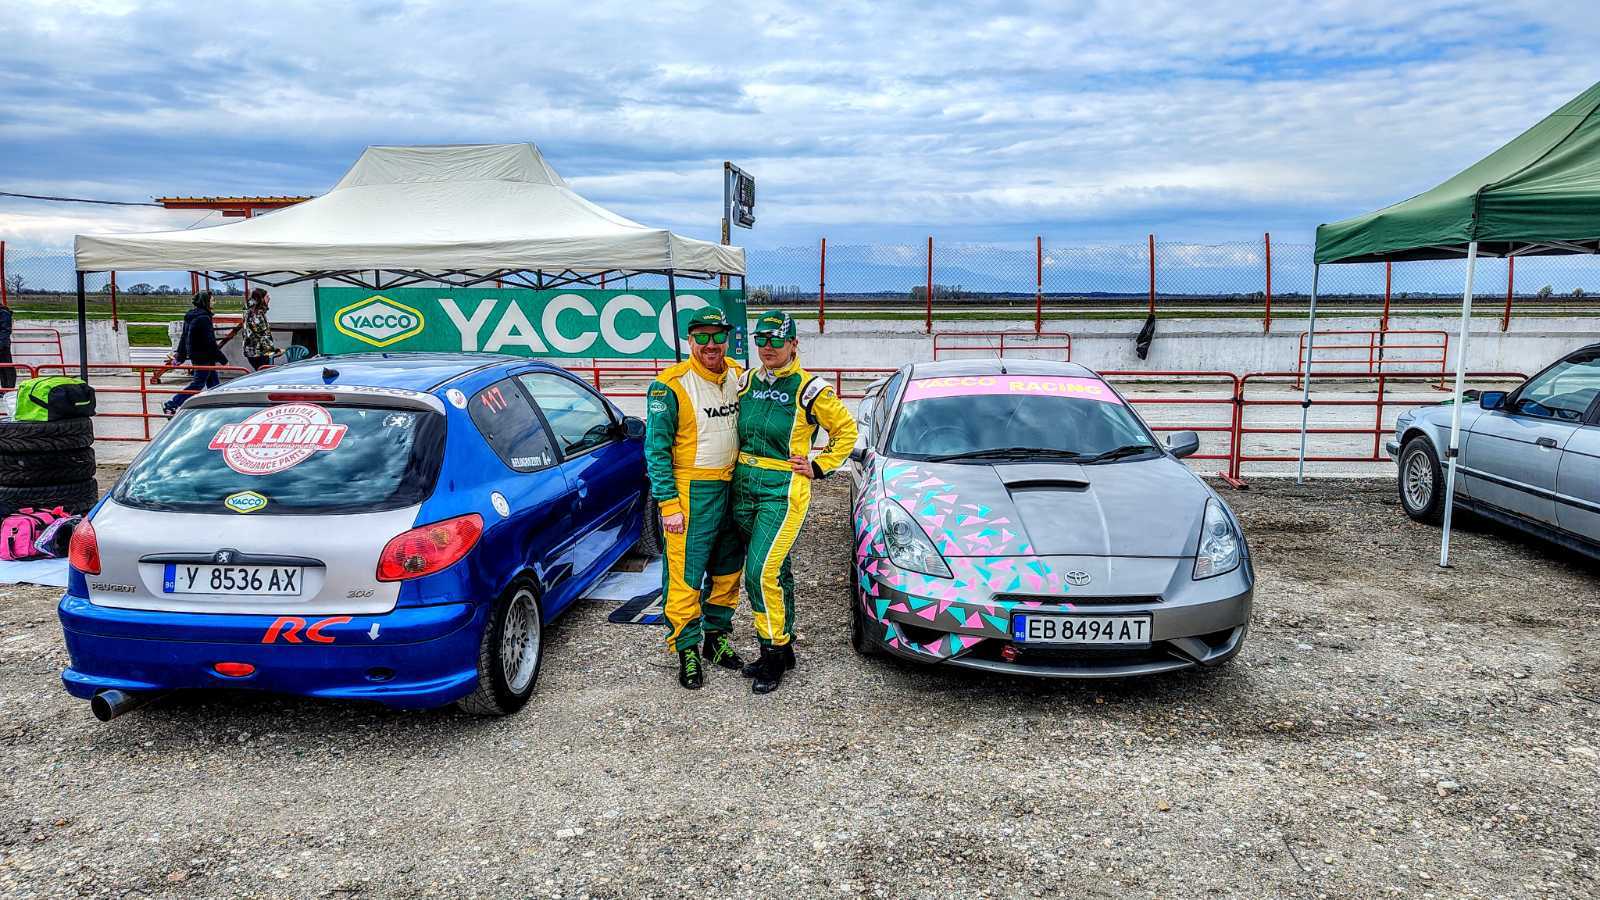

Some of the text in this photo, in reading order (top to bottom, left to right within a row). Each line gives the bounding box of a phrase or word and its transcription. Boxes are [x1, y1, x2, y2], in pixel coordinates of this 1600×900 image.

[348, 314, 412, 329] YACCO
[916, 376, 1103, 395] YACCO RACING
[752, 389, 789, 403] YACCO
[264, 406, 318, 420] ORIGINAL
[215, 424, 260, 444] NO
[279, 449, 308, 466] PARTS
[231, 498, 262, 506] YACCO
[186, 567, 199, 589] Y
[210, 567, 263, 591] 8536
[268, 568, 297, 591] AX
[91, 582, 137, 593] PEUGEOT
[346, 588, 375, 599] 206
[261, 616, 353, 644] RC
[1015, 619, 1146, 641] BG EB 8494 AT
